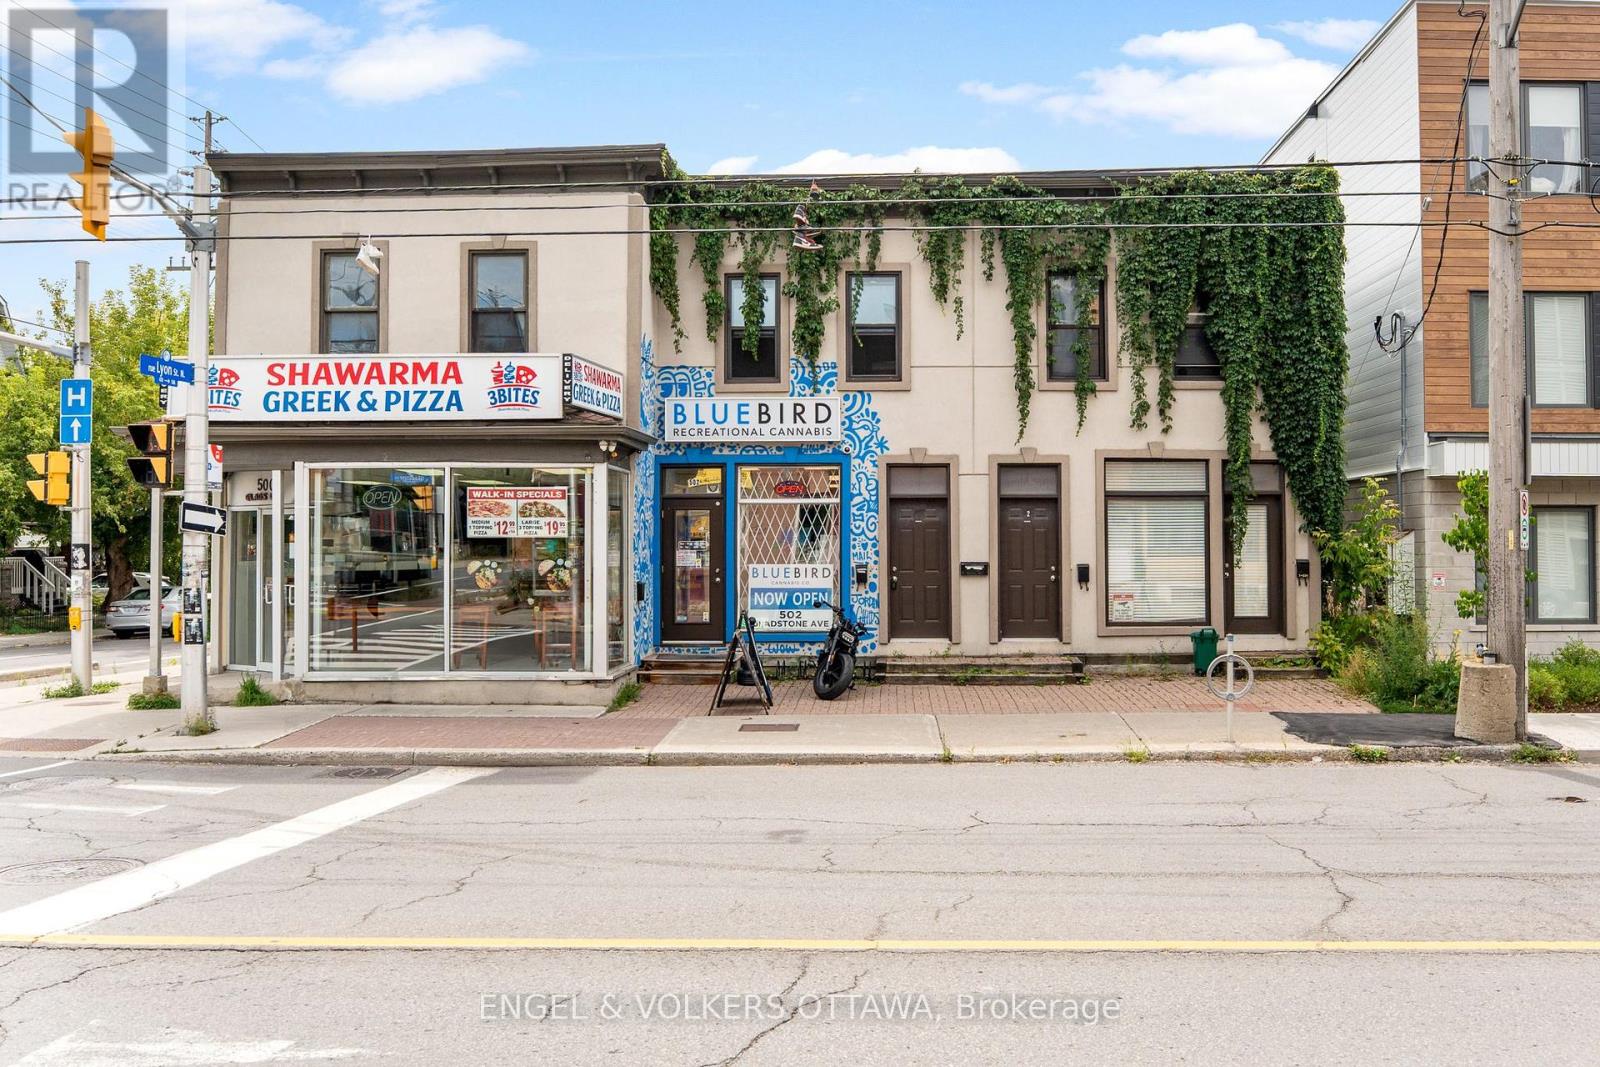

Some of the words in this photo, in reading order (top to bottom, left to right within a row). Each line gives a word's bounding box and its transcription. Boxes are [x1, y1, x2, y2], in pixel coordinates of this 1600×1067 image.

[156, 361, 173, 377] Lyon
[266, 362, 463, 386] SHAWARMA
[563, 356, 572, 402] DELIVERY
[583, 364, 621, 394] SHAWARMA
[67, 387, 86, 407] H
[207, 389, 242, 407] ITES
[263, 390, 351, 413] GREEK
[356, 390, 378, 412] &
[385, 390, 464, 412] PIZZA
[487, 387, 540, 406] 3BITES
[573, 383, 595, 406] GREEK
[596, 390, 601, 407] &
[602, 392, 621, 413] PIZZA
[673, 402, 832, 425] BLUEBIRD
[673, 427, 765, 437] RECREATIONAL
[769, 427, 832, 436] CANNABIS
[365, 490, 398, 504] OPEN
[775, 484, 804, 494] OPEN
[752, 567, 831, 579] BLUEBIRD
[753, 591, 788, 606] NOW
[792, 591, 829, 606] OPEN
[779, 610, 802, 619] 502
[810, 620, 829, 628] AVE
